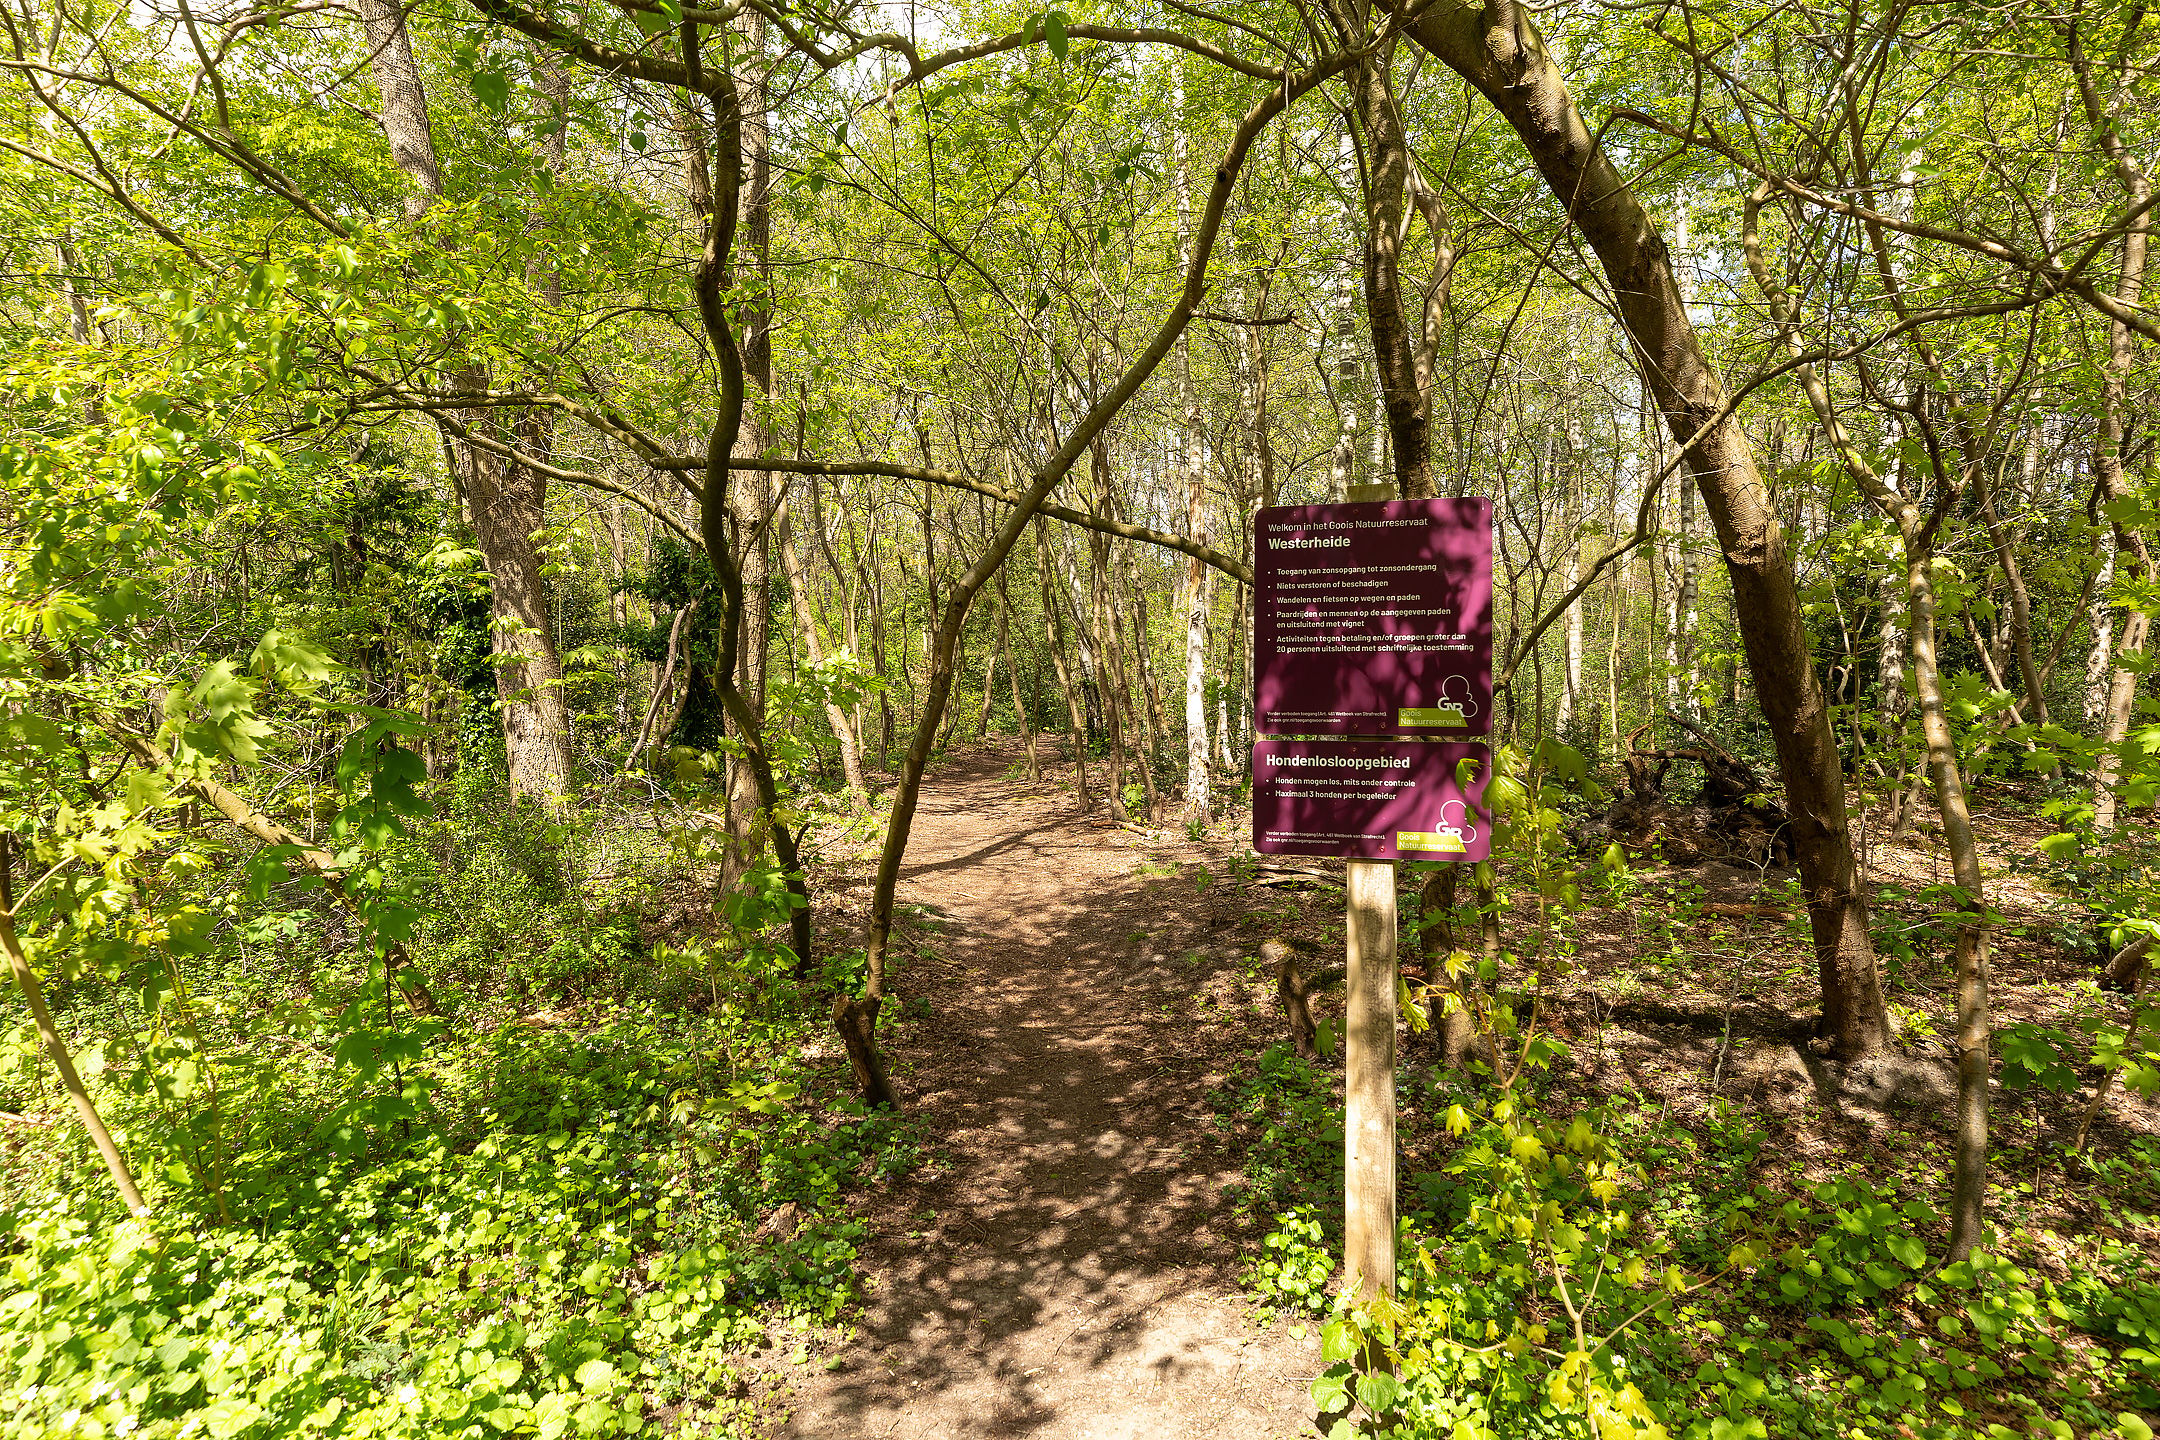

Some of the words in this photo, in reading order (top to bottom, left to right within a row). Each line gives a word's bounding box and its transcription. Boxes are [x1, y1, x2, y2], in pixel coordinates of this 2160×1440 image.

[1268, 524, 1302, 532] Welkom
[1303, 523, 1311, 531] in
[1313, 522, 1327, 530] het
[1328, 521, 1354, 530] Goois
[1355, 518, 1428, 528] Natuurreservaat
[1268, 535, 1351, 550] Westerheide
[1277, 568, 1307, 576] Toegang
[1322, 566, 1366, 574] zonsopgang
[1380, 563, 1437, 572] zonsondergang
[1341, 580, 1388, 588] beschadigen
[1276, 610, 1318, 619] Paardrijden
[1381, 608, 1426, 617] aangegeven
[1427, 608, 1451, 616] paden
[1342, 620, 1365, 628] vignet
[1276, 635, 1318, 643] Activiteiten
[1319, 636, 1340, 644] tegen
[1342, 634, 1371, 643] betaling
[1373, 633, 1394, 641] en/of
[1394, 634, 1425, 642] groepen
[1426, 634, 1450, 642] groter
[1287, 646, 1321, 654] personen
[1377, 643, 1422, 652] schriftelijke
[1423, 644, 1474, 652] toestemming
[1266, 754, 1410, 771] Hondenlosloopgebied
[1276, 777, 1302, 785] Honden
[1329, 778, 1342, 786] los,
[1343, 778, 1360, 786] mits
[1384, 779, 1416, 787] controle
[1276, 790, 1308, 798] Maximaal
[1315, 791, 1342, 799] honden
[1357, 791, 1396, 800] begeleider
[1399, 842, 1460, 850] Natuurreservaat
